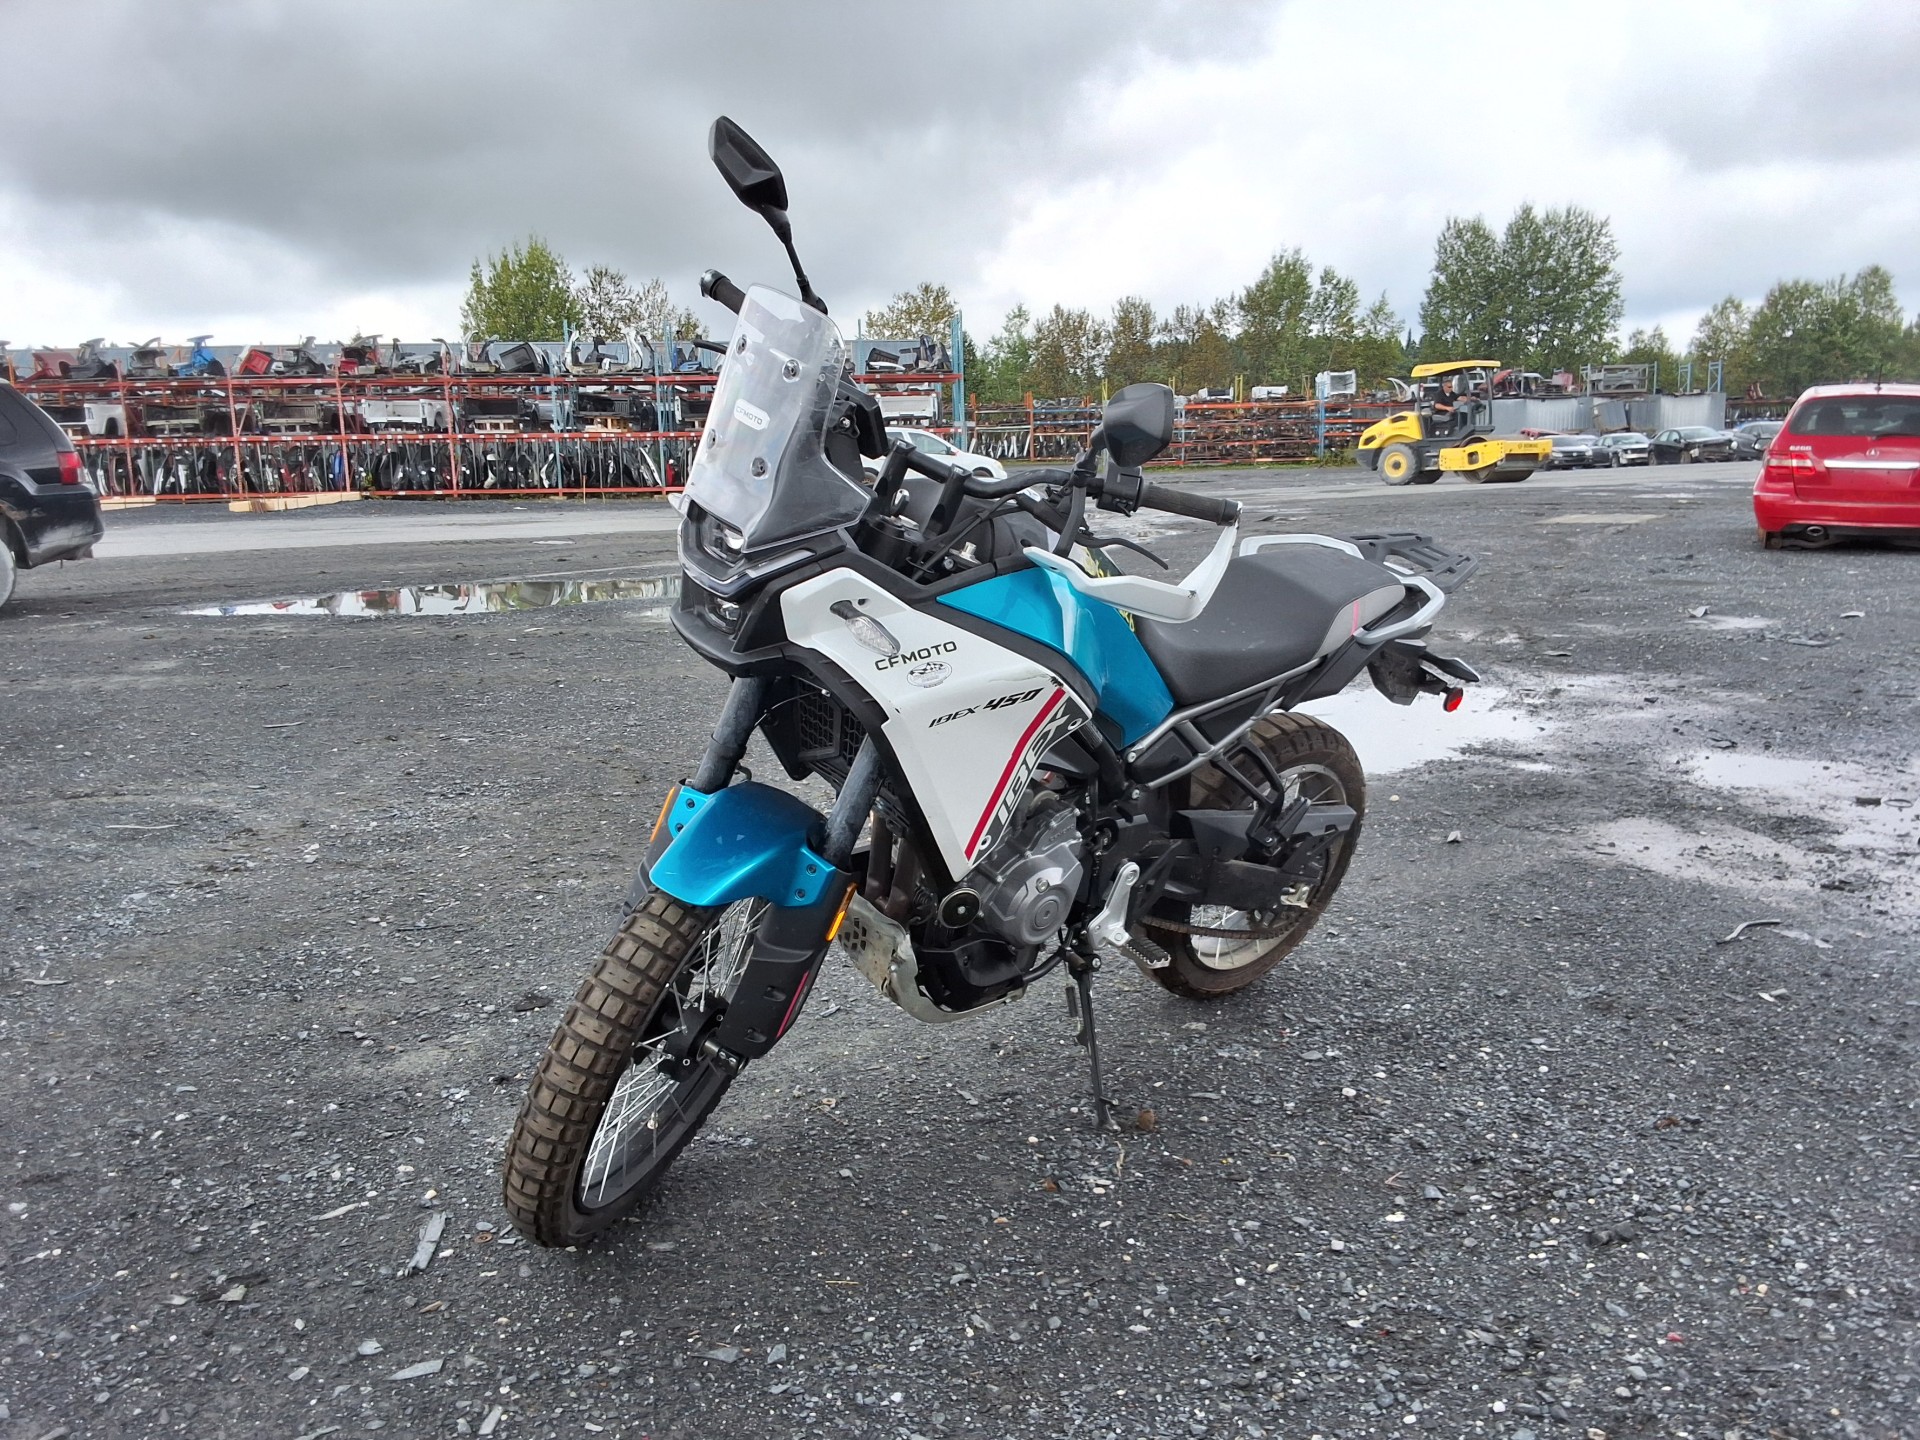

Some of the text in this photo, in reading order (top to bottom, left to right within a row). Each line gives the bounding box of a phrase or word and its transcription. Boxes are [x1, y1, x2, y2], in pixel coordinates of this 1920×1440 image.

[875, 641, 957, 671] CFMOTO
[928, 687, 1045, 728] IBEX 450
[998, 702, 1071, 826] IBEX
